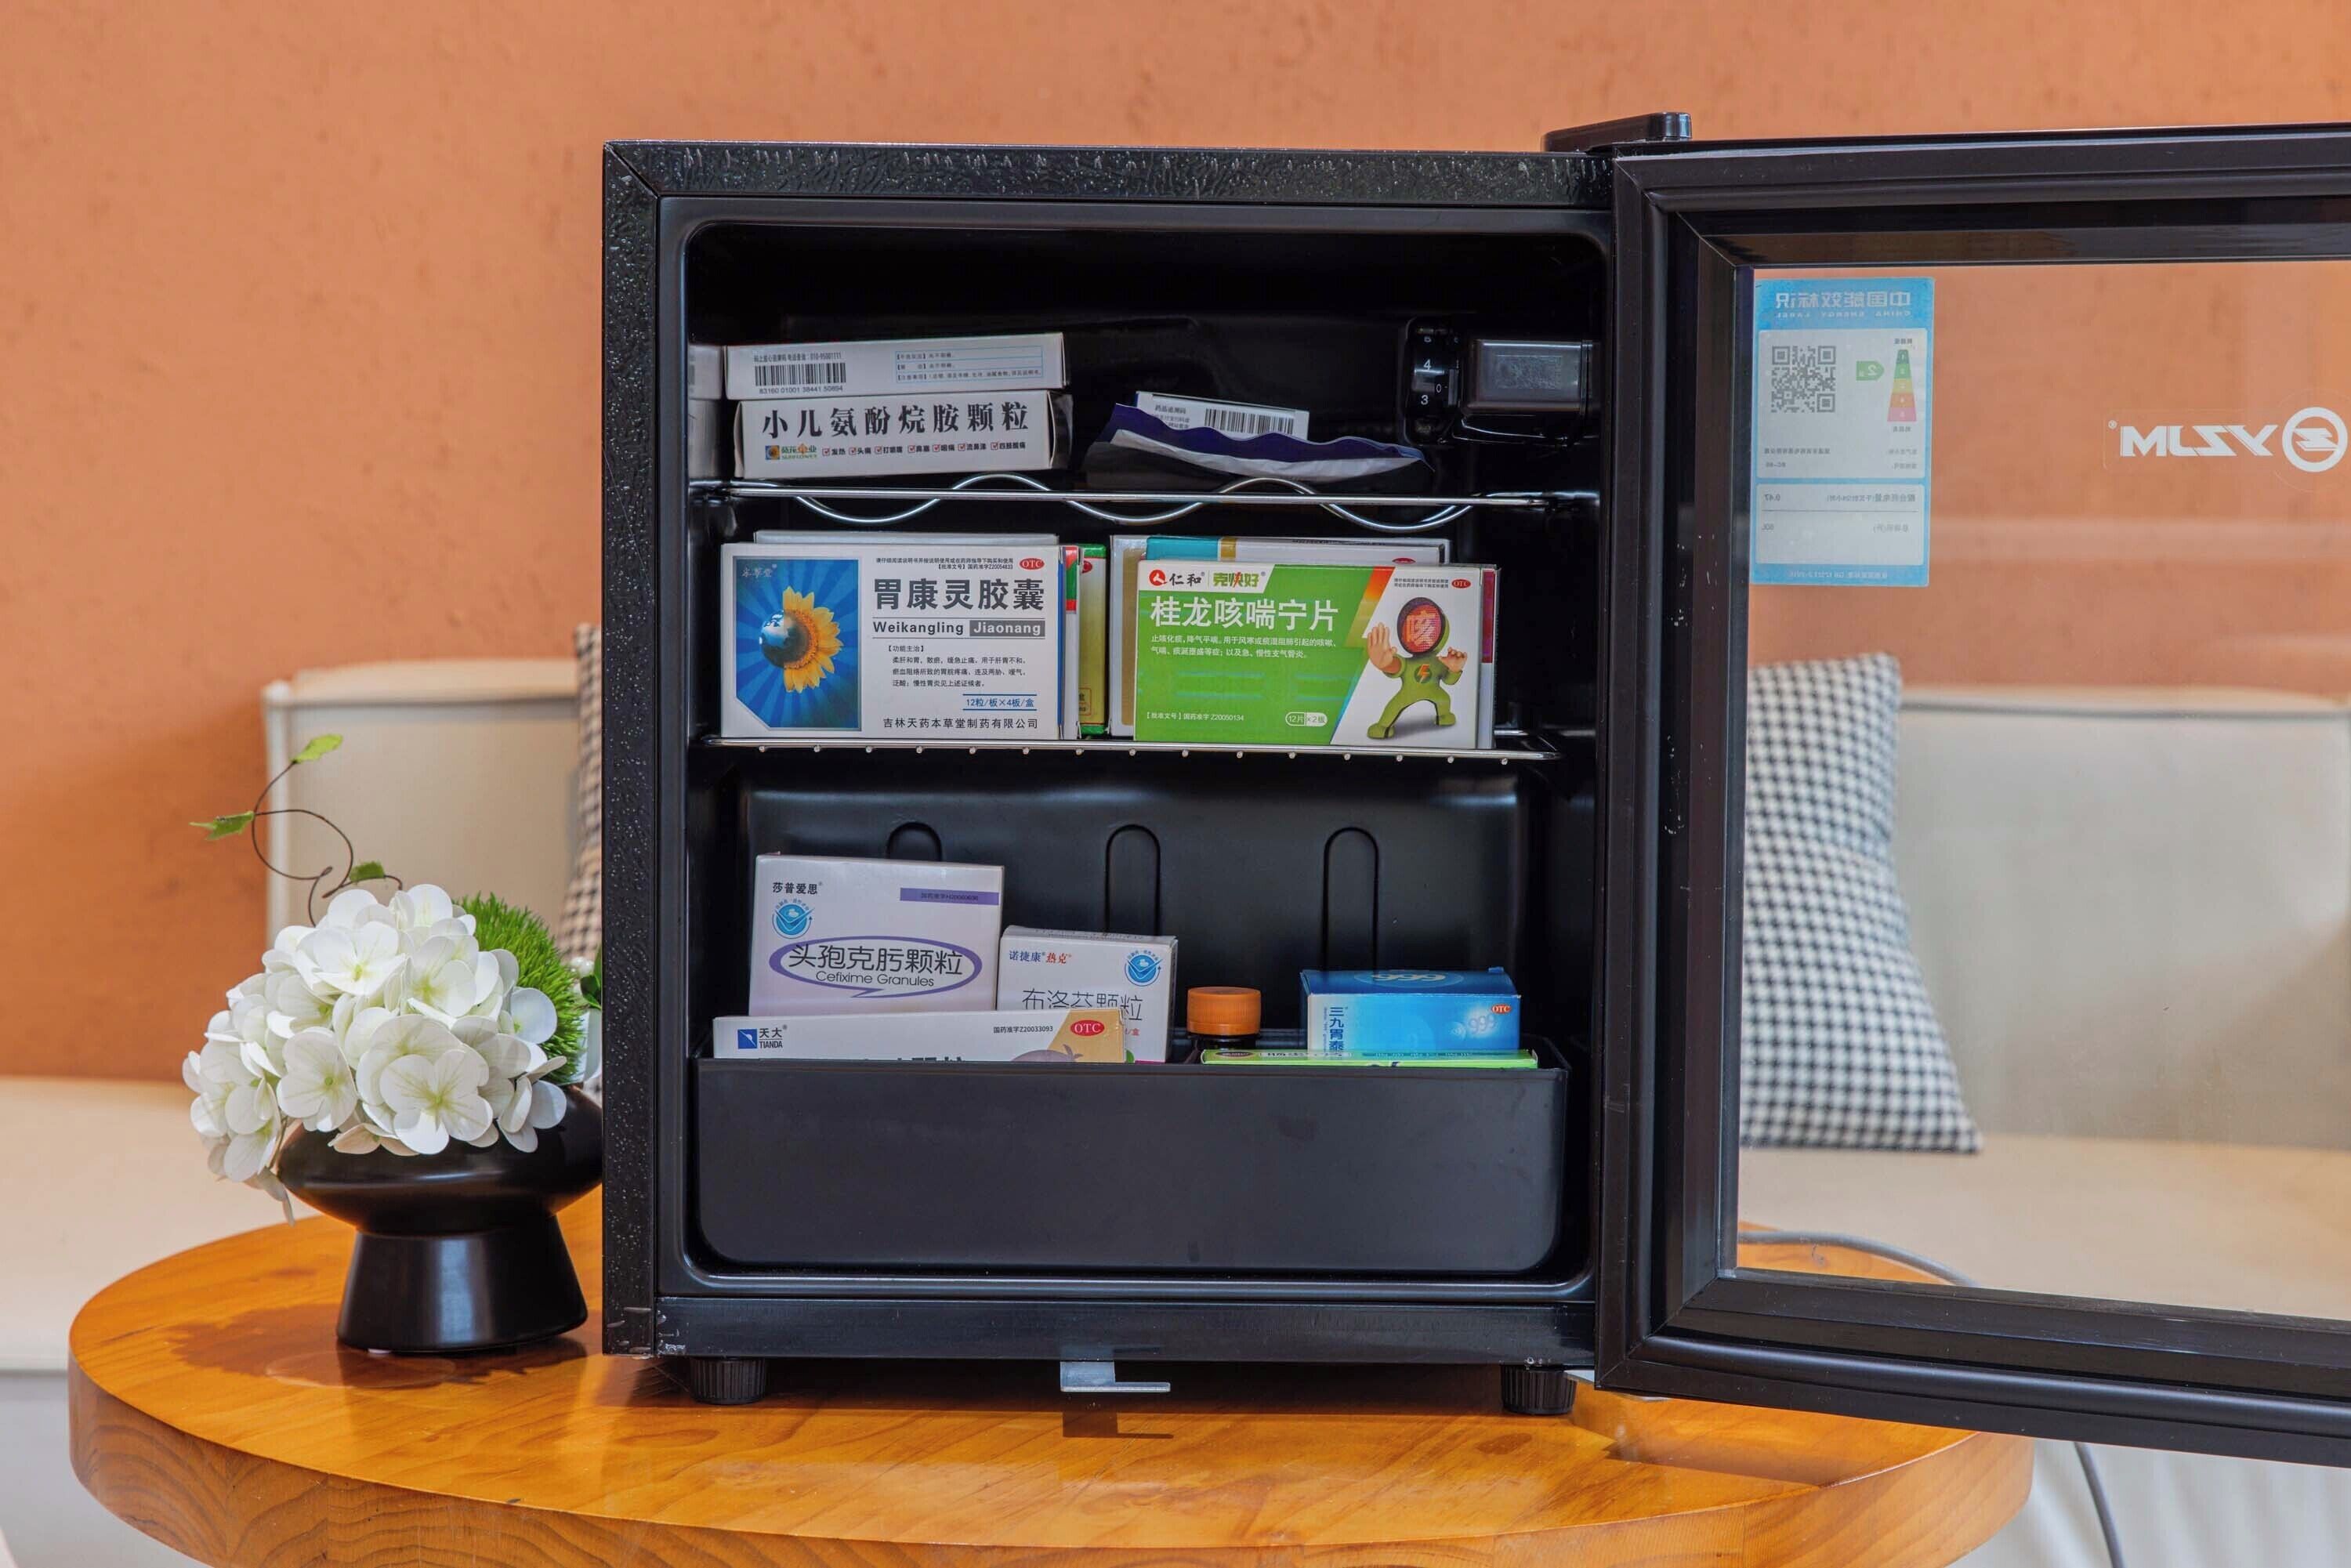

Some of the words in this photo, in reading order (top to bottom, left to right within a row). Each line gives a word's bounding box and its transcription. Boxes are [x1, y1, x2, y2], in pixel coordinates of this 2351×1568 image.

[1424, 359, 1432, 370] 4
[1421, 394, 1429, 405] 3
[763, 401, 1029, 439] 小儿氨酚烷胺颗粒
[1169, 573, 1202, 587] 仁和
[873, 578, 1045, 611] 胃康灵胶囊
[1150, 596, 1339, 632] 桂龙咳喘宁片
[873, 621, 964, 636] Weikangling
[974, 621, 1041, 636] Jiaonang
[966, 698, 1035, 708] 12粒/板×4板/盒
[883, 718, 1039, 730] 吉林天药本草堂制药有限公司
[772, 882, 818, 895] 莎普爱思
[788, 943, 963, 976] 头孢克肟颗粒
[1009, 951, 1041, 963] 诺捷康
[1045, 952, 1068, 965] 热克
[816, 970, 873, 984] Cefixime
[877, 973, 935, 987] Granules
[1022, 987, 1143, 1021] 布洛芬颗粒
[1491, 1005, 1512, 1014] OTC
[759, 1027, 783, 1039] 天大
[994, 1026, 1054, 1034] 国药准字Z20033093
[1074, 1023, 1103, 1034] OTC
[759, 1041, 783, 1049] TIANDA
